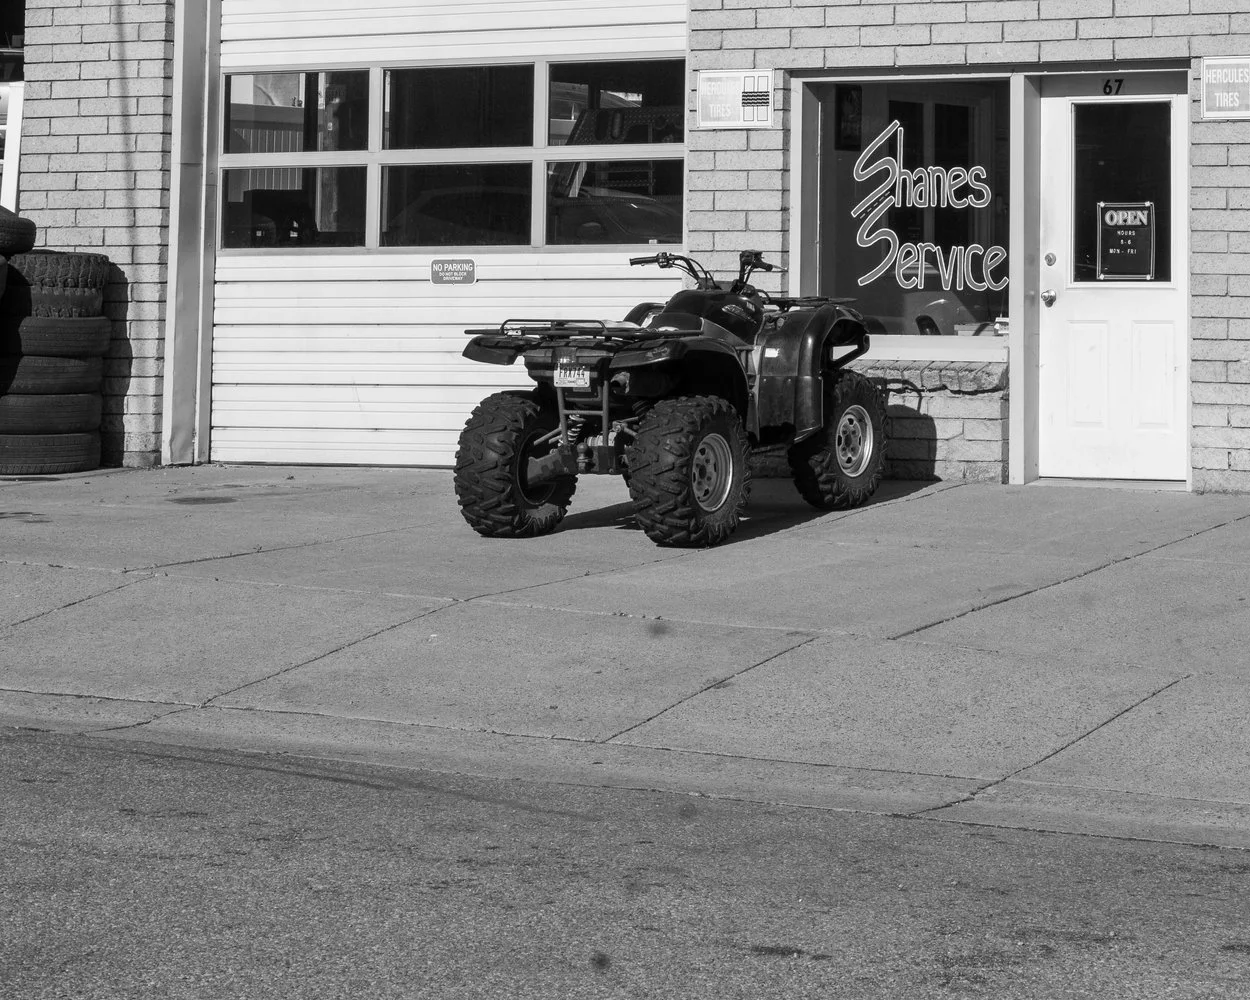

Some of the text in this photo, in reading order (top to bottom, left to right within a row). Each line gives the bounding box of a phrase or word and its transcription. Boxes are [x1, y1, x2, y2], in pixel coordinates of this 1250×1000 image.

[1205, 68, 1249, 84] HERCULES
[1103, 79, 1124, 95] 67
[1214, 92, 1240, 107] TIRES
[709, 103, 732, 118] TIRES
[851, 119, 992, 218] Shanes
[1104, 209, 1149, 226] OPEN
[857, 195, 1009, 291] Service
[432, 263, 474, 271] NO PARKING
